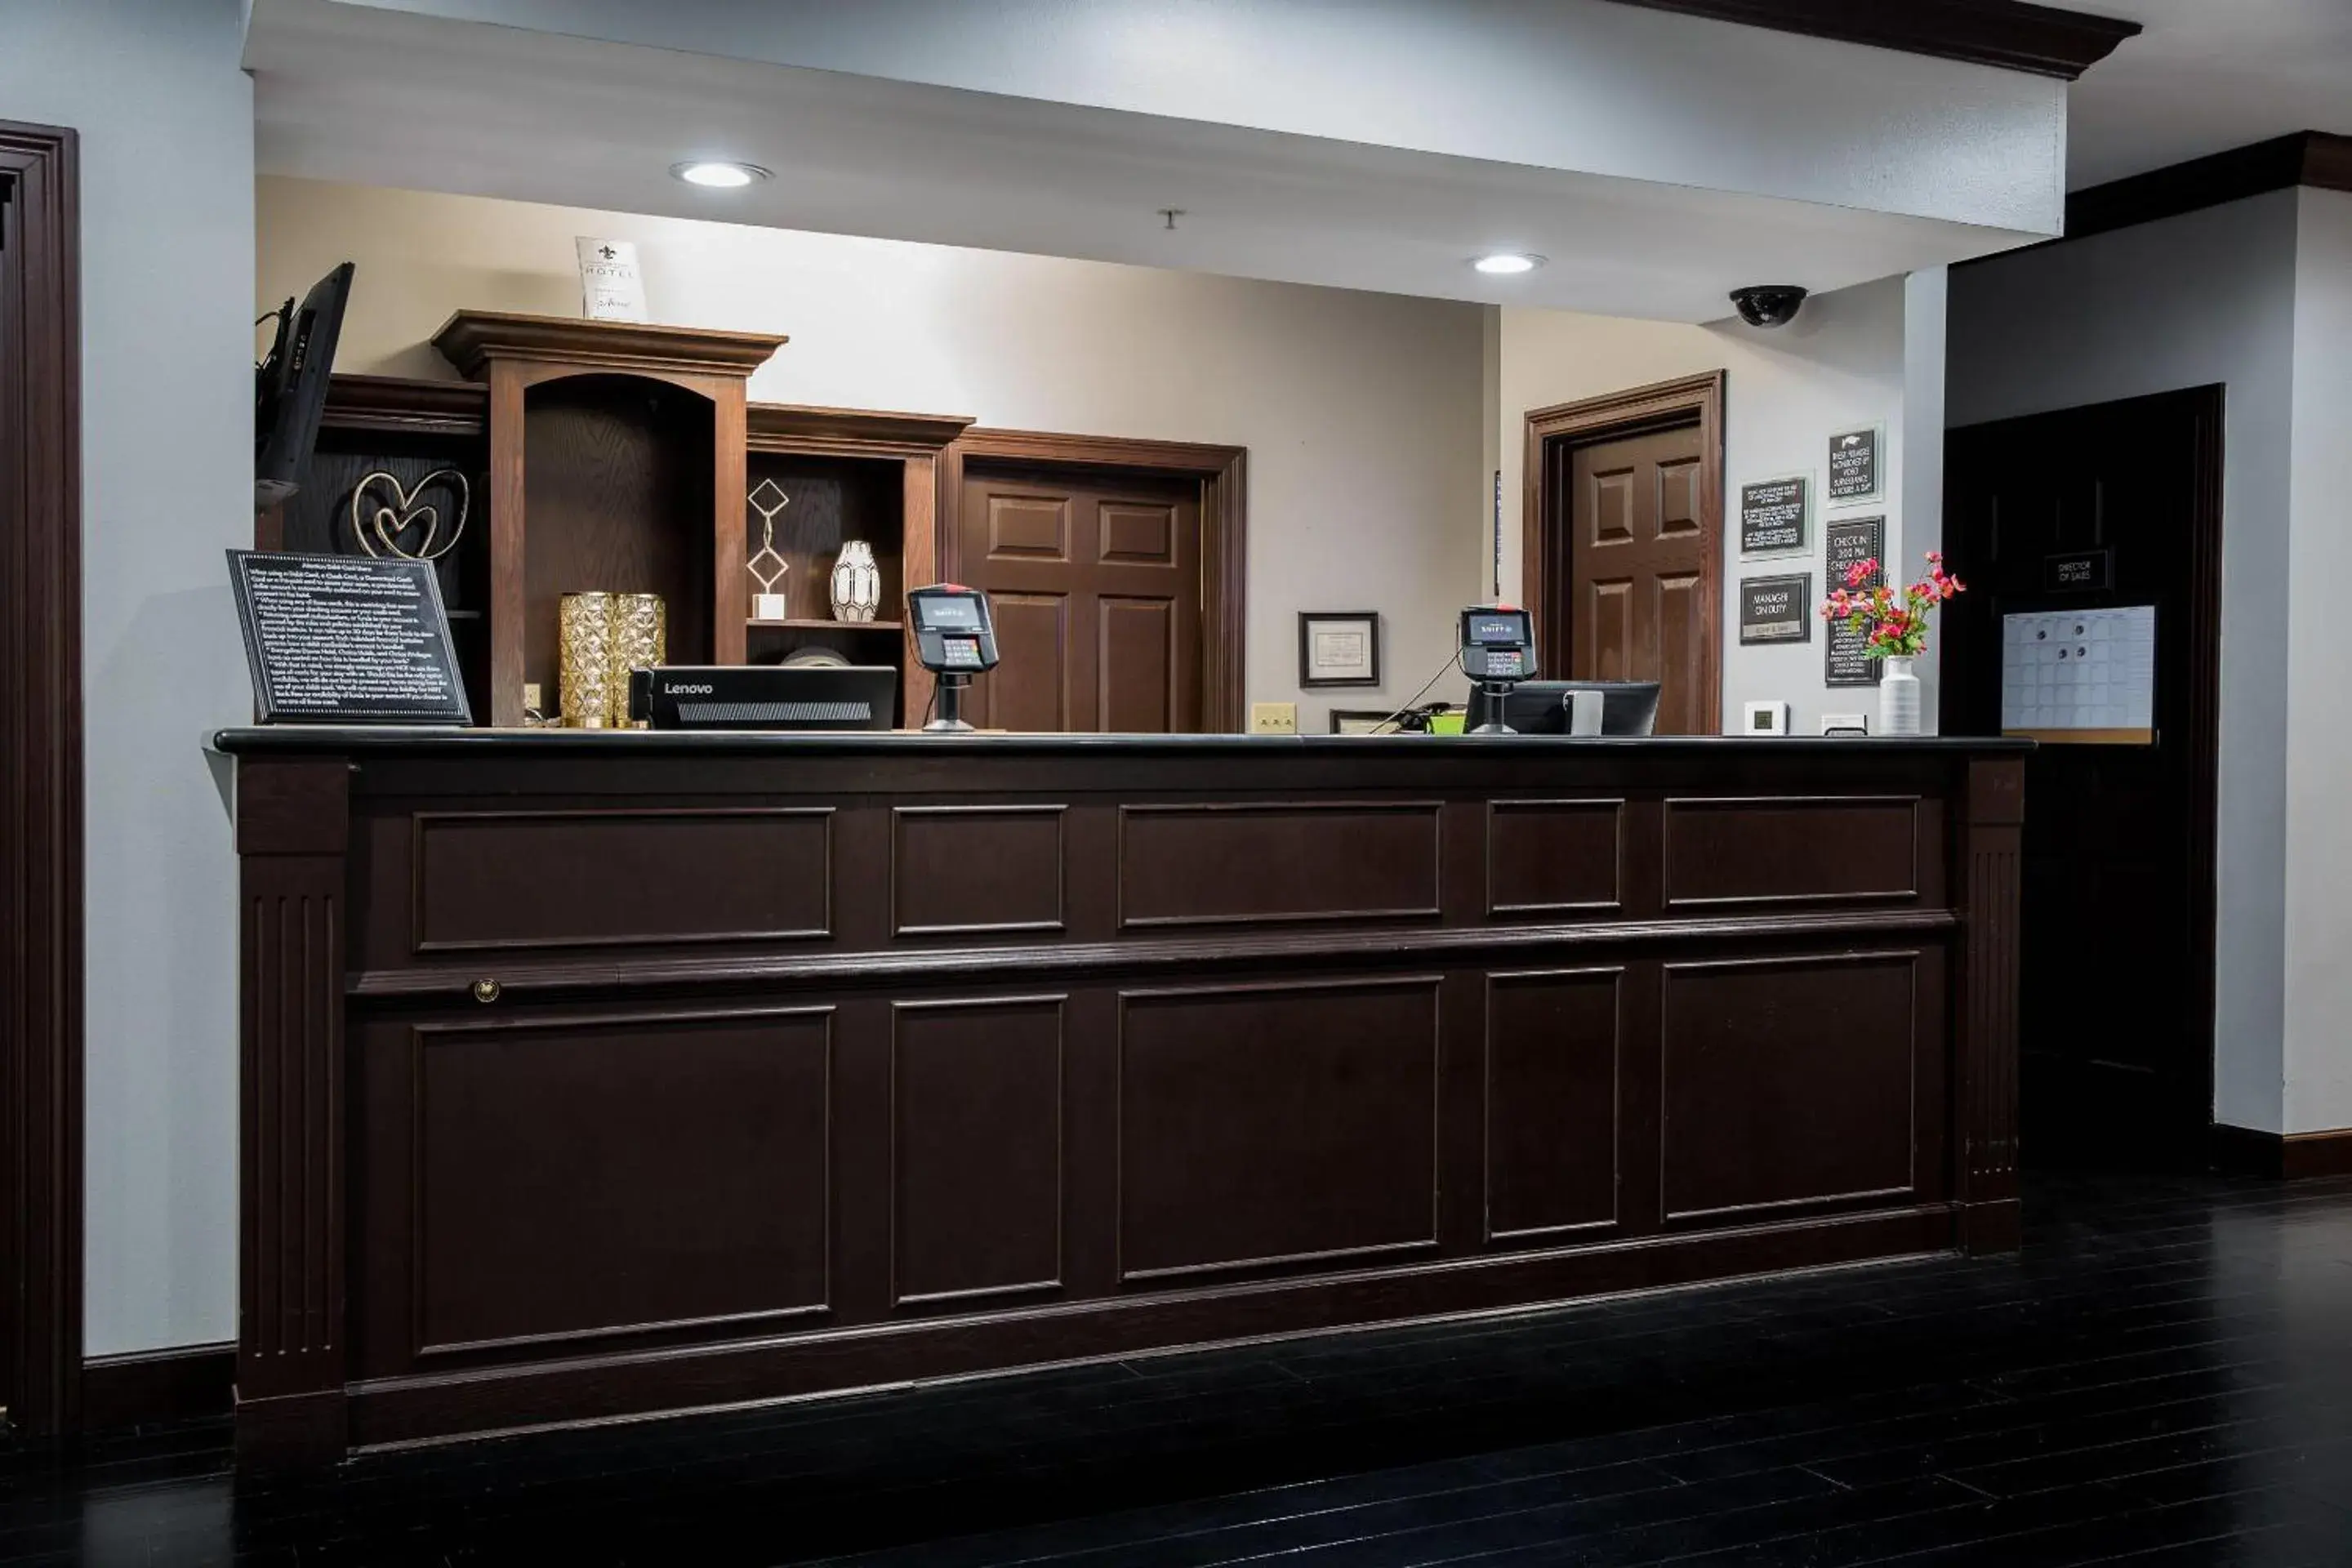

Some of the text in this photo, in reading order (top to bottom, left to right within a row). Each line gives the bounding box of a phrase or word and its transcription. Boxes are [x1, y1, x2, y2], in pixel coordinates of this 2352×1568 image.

[1833, 536, 1858, 548] CHECK
[1753, 592, 1789, 605] MANAGER
[1755, 604, 1788, 616] ON DUTY
[665, 683, 713, 694] Lenovo
